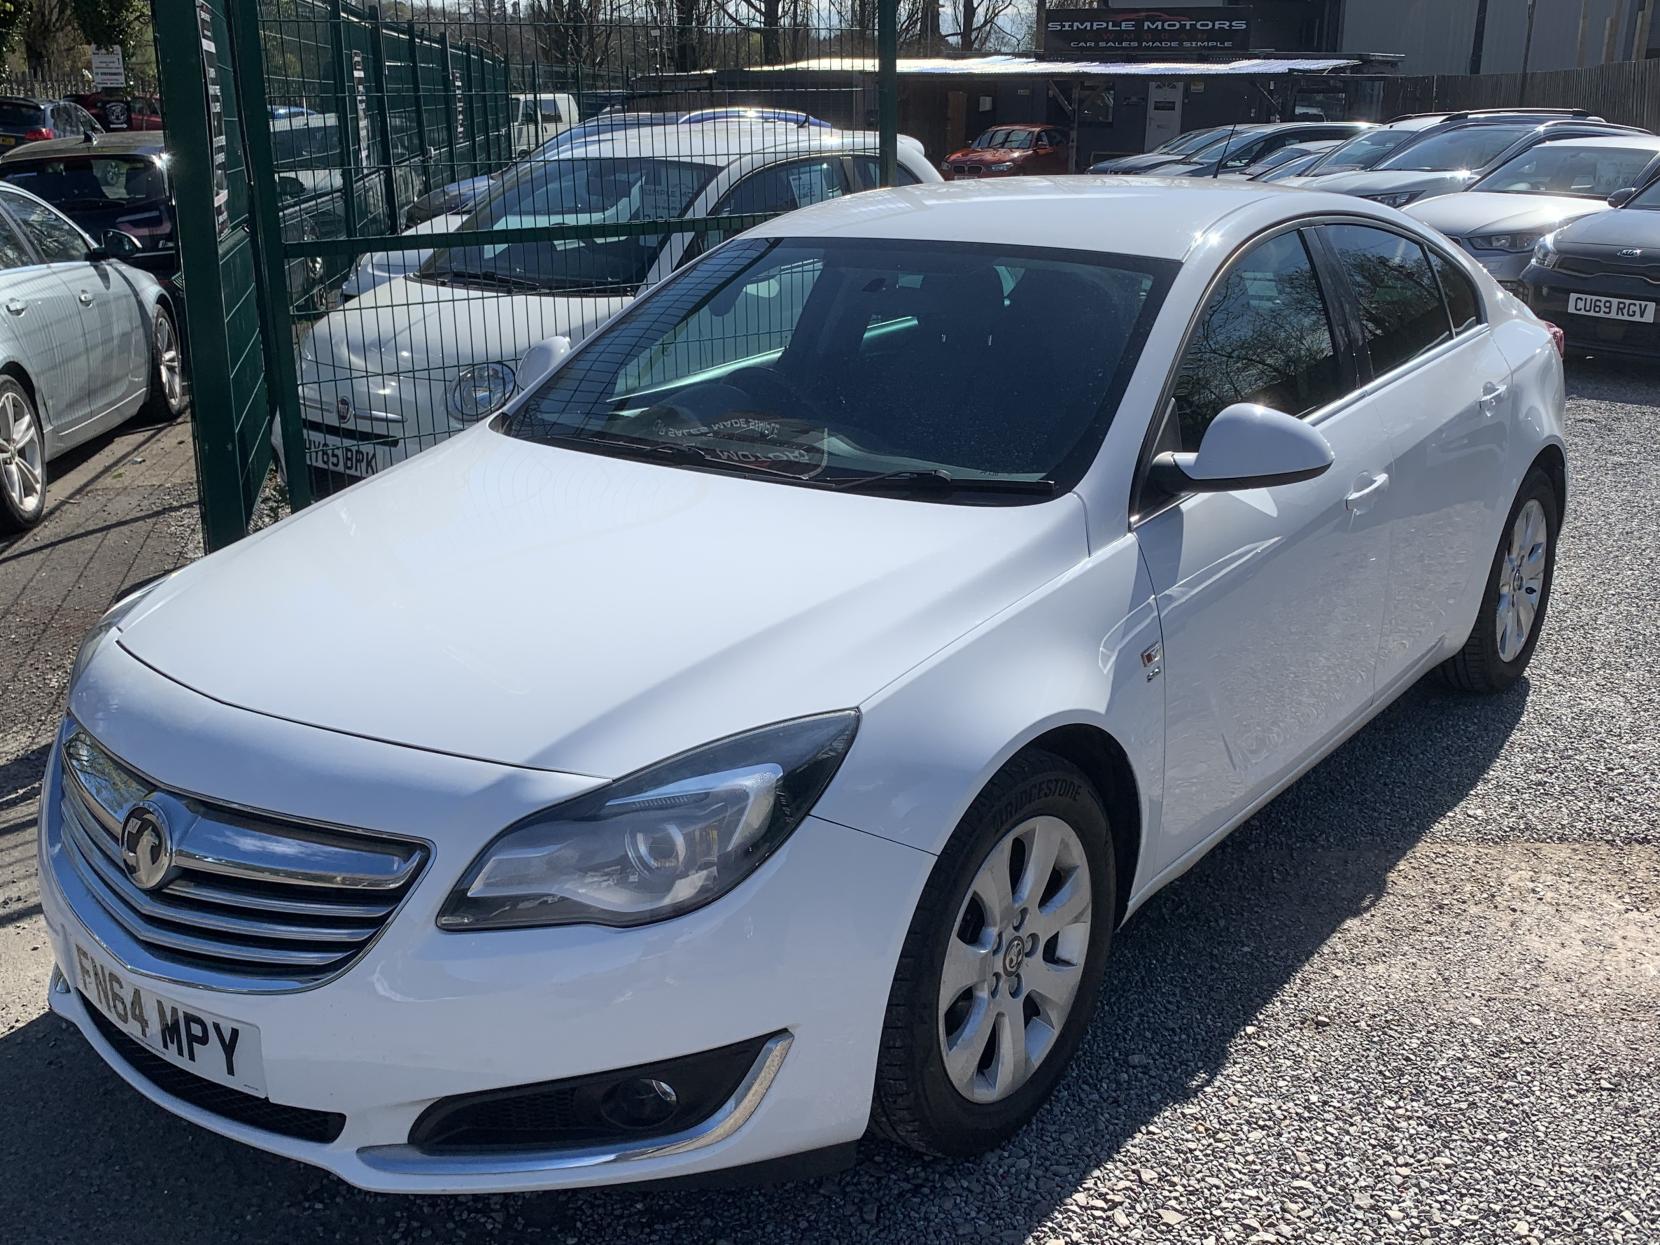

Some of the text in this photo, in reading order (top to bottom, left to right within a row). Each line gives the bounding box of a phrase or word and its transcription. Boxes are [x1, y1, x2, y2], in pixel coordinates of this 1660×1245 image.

[1047, 20, 1247, 31] SIMPLE MOTORS
[1573, 296, 1648, 318] CU69 RGV
[345, 448, 377, 475] BPK
[75, 943, 240, 1077] FN64 MPY
